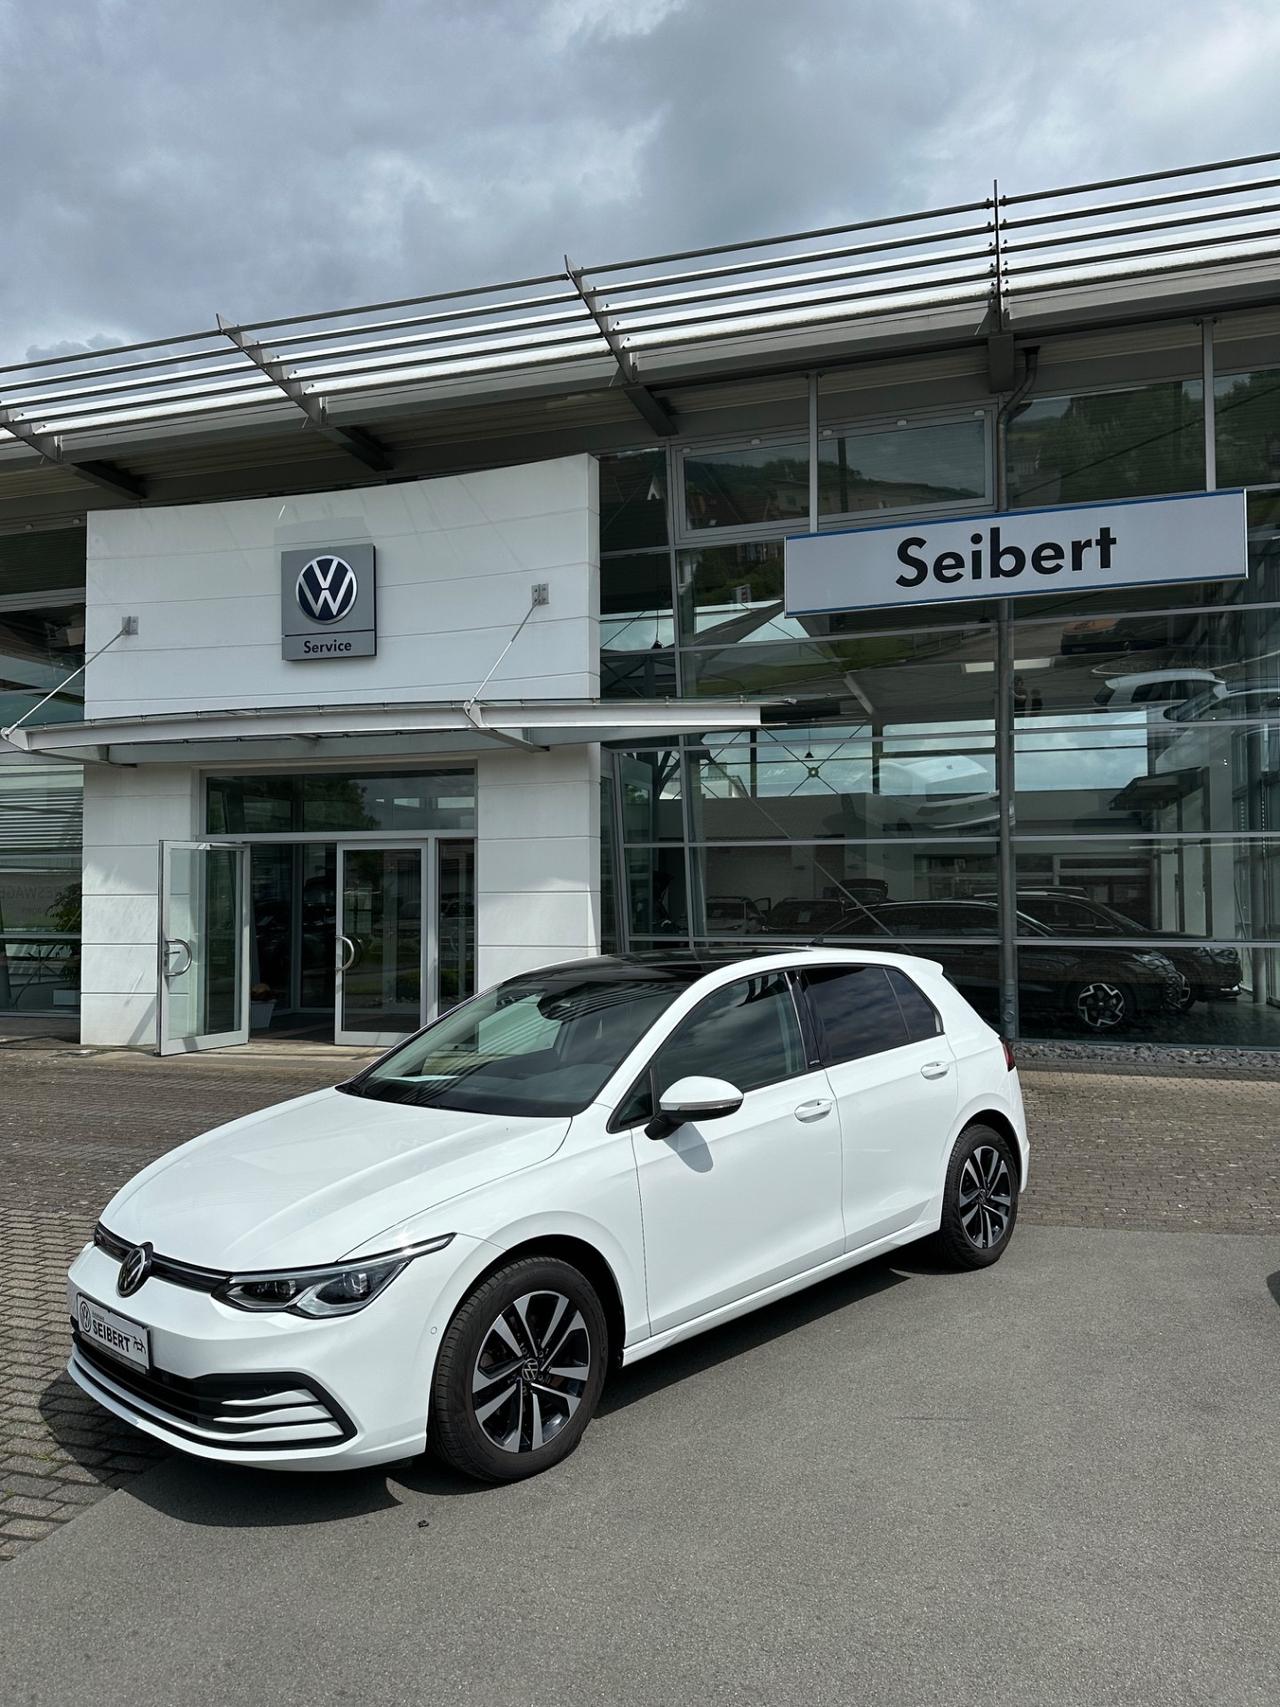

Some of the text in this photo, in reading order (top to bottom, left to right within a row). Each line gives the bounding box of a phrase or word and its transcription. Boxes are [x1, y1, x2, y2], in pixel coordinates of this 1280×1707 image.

[895, 526, 1118, 588] Seibert
[297, 555, 356, 622] VW
[303, 638, 352, 654] Service
[92, 1319, 131, 1353] SEIBERT
